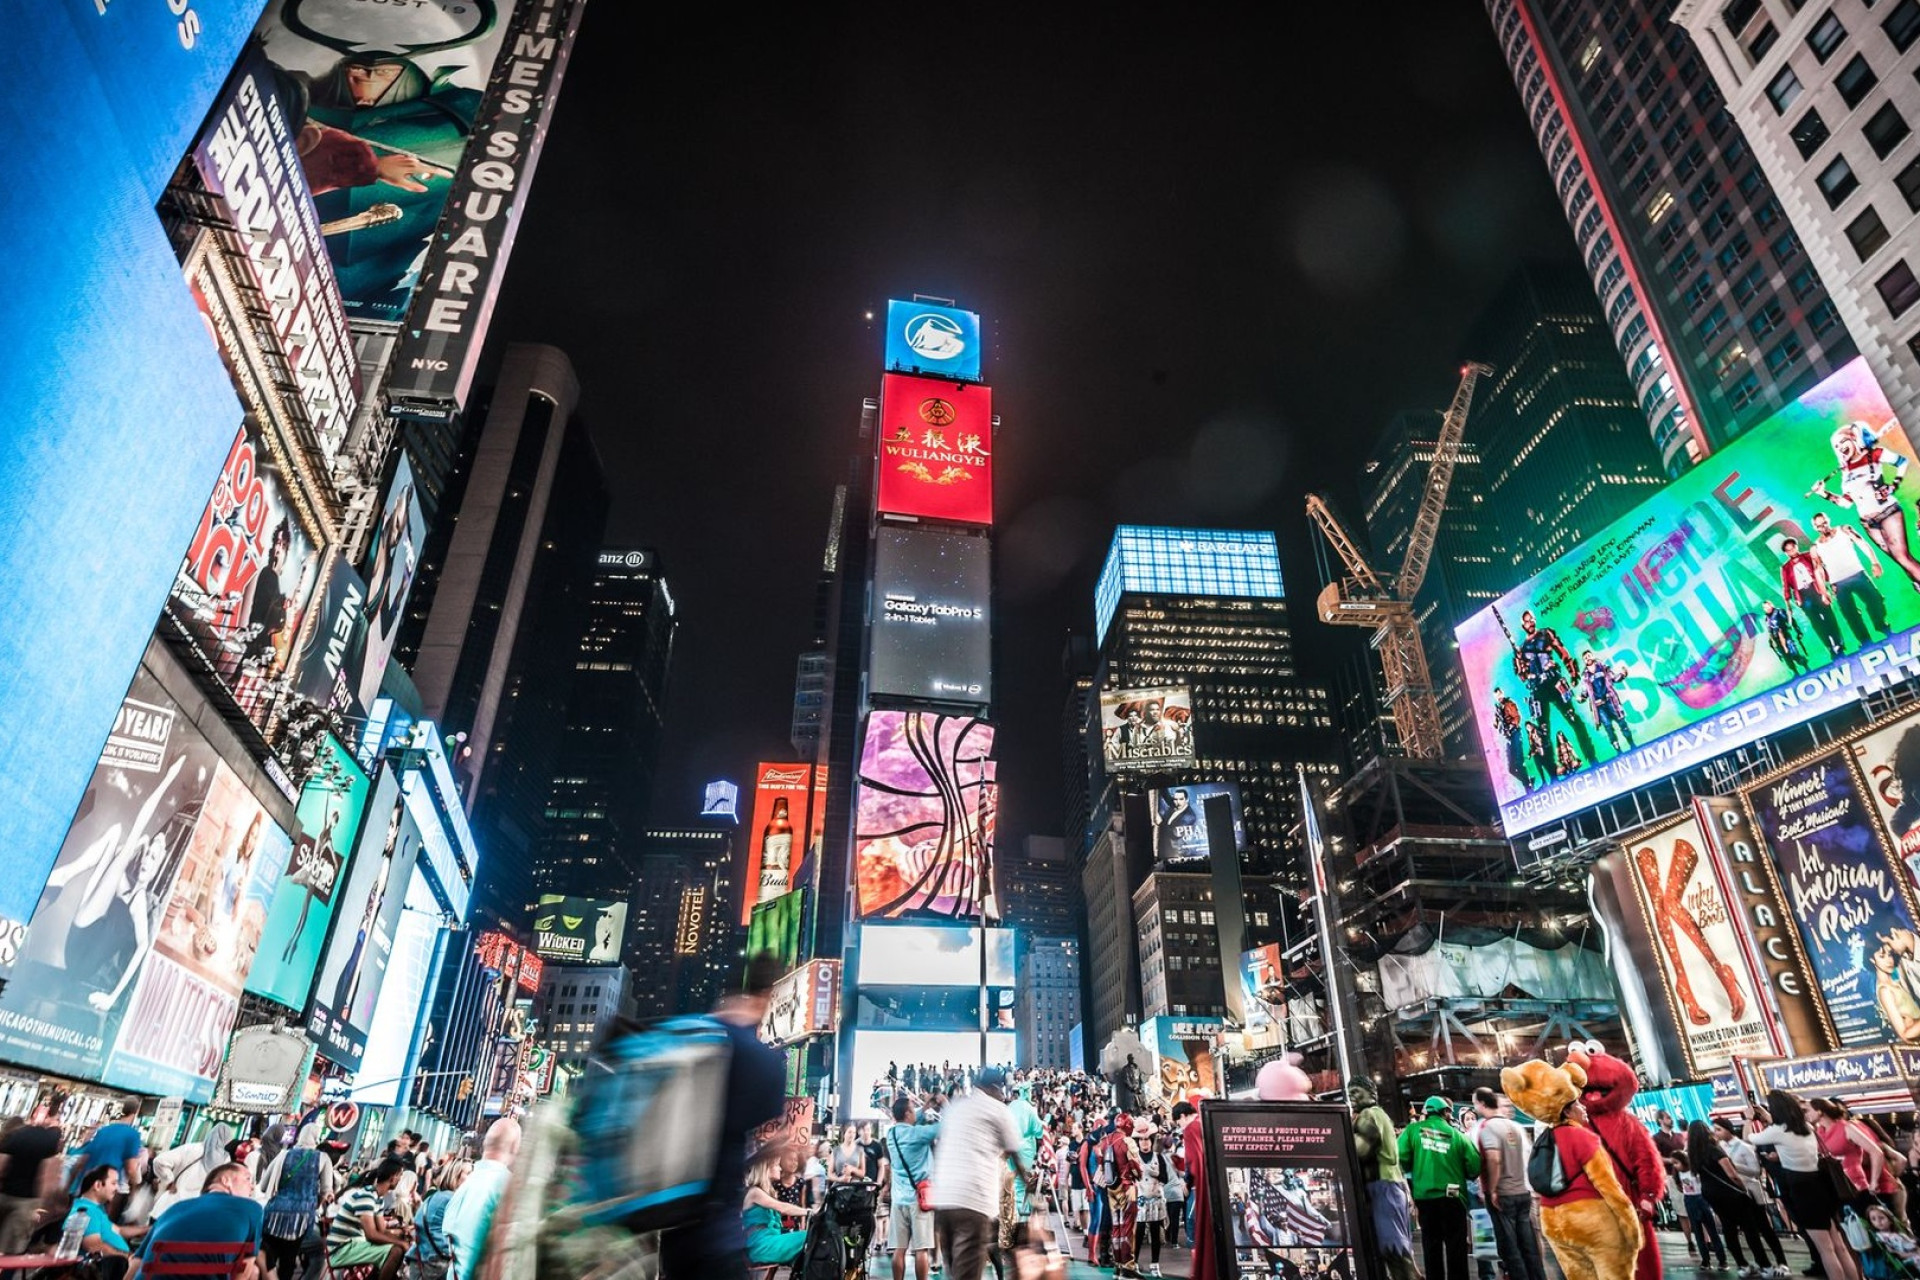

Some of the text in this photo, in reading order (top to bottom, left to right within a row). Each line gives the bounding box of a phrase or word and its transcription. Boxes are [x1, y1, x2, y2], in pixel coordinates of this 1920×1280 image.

[424, 0, 559, 333] IMES SQUARE
[238, 74, 284, 195] CYNTHIA
[274, 183, 309, 264] ERIVO
[300, 265, 339, 360] HEATHER
[326, 345, 359, 426] HEADLEY
[207, 95, 347, 472] THE COLOR PURPLE
[411, 358, 449, 372] NYC
[886, 446, 986, 467] WULIANGYE
[1198, 541, 1270, 555] BARCLAYS
[1573, 471, 1774, 650] SUICIDE
[303, 582, 362, 680] NEW
[884, 600, 983, 619] Galaxy TabPro S
[884, 612, 937, 625] 2-in-1 Tablet
[123, 707, 171, 743] YEARS
[1508, 772, 1594, 823] EXPERIENCE
[1596, 766, 1610, 788] IT
[1611, 756, 1633, 781] IN
[1634, 722, 1716, 770] IMAX
[1718, 701, 1769, 737] 3D
[1771, 663, 1853, 713] NOW
[1771, 765, 1826, 808] Winner!
[1777, 798, 1851, 842] Best Musical!
[1796, 840, 1825, 882] An
[1721, 810, 1800, 996] PALACE
[1790, 862, 1895, 922] American
[685, 886, 705, 954] NOVOTEL
[1699, 905, 1727, 929] Boots
[1818, 895, 1875, 944] Paris
[538, 931, 586, 951] WICKED
[815, 962, 834, 1030] HELLO!
[0, 1008, 104, 1052] ICAGOTHEMUSICAL.COM
[1722, 1026, 1740, 1040] TONY
[1740, 1021, 1766, 1037] AWARD
[1221, 1126, 1231, 1134] IF
[1231, 1126, 1246, 1134] YOU
[1247, 1126, 1267, 1134] TAKE
[1275, 1127, 1299, 1135] PHOTO
[1300, 1127, 1320, 1135] WITH
[1222, 1134, 1275, 1143] ENTERTAINER,
[1223, 1143, 1243, 1151] THEY
[1281, 1144, 1295, 1152] TIP
